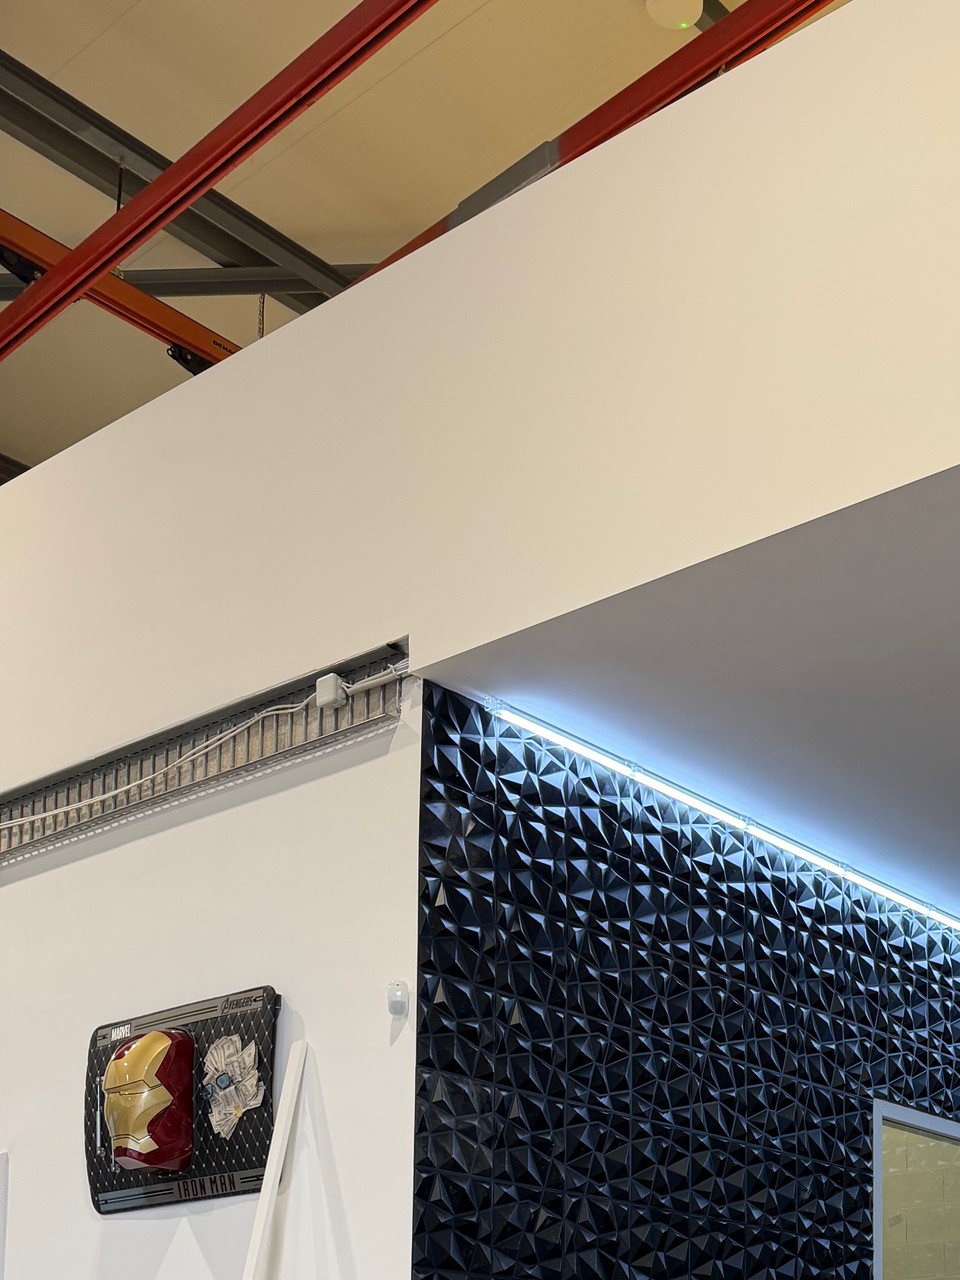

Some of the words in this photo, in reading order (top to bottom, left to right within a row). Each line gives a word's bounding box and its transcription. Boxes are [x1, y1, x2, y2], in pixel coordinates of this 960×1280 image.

[111, 1024, 131, 1041] MARVEL
[177, 1178, 206, 1199] IRON
[209, 1173, 236, 1194] MAN
